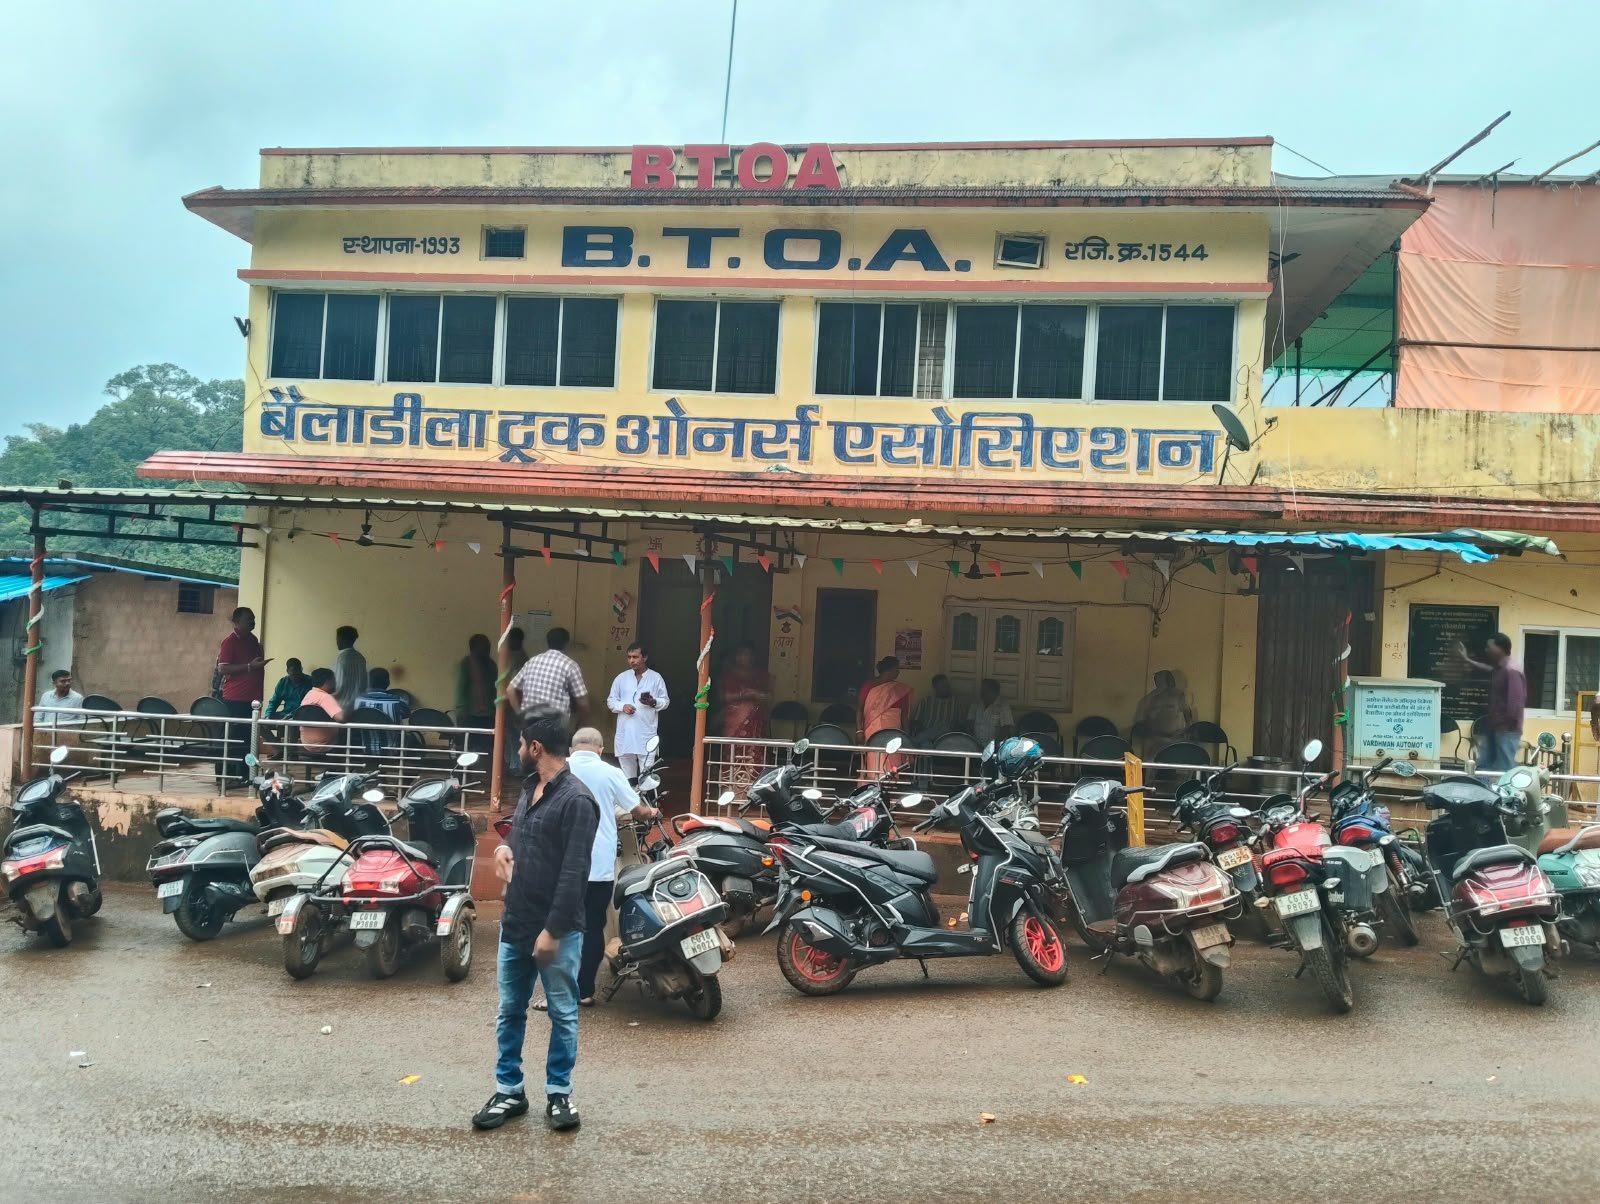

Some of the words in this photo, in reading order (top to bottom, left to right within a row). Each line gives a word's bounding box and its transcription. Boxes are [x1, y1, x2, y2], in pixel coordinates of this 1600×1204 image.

[631, 143, 842, 190] BTOA
[561, 226, 971, 272] B.T.O.A.
[260, 386, 493, 449] बैलाडीला
[498, 409, 606, 463] ट्रक
[616, 397, 821, 462] ओनर्स
[827, 406, 1222, 473] एसोसिएशन
[1363, 739, 1395, 748] VARDHMAN
